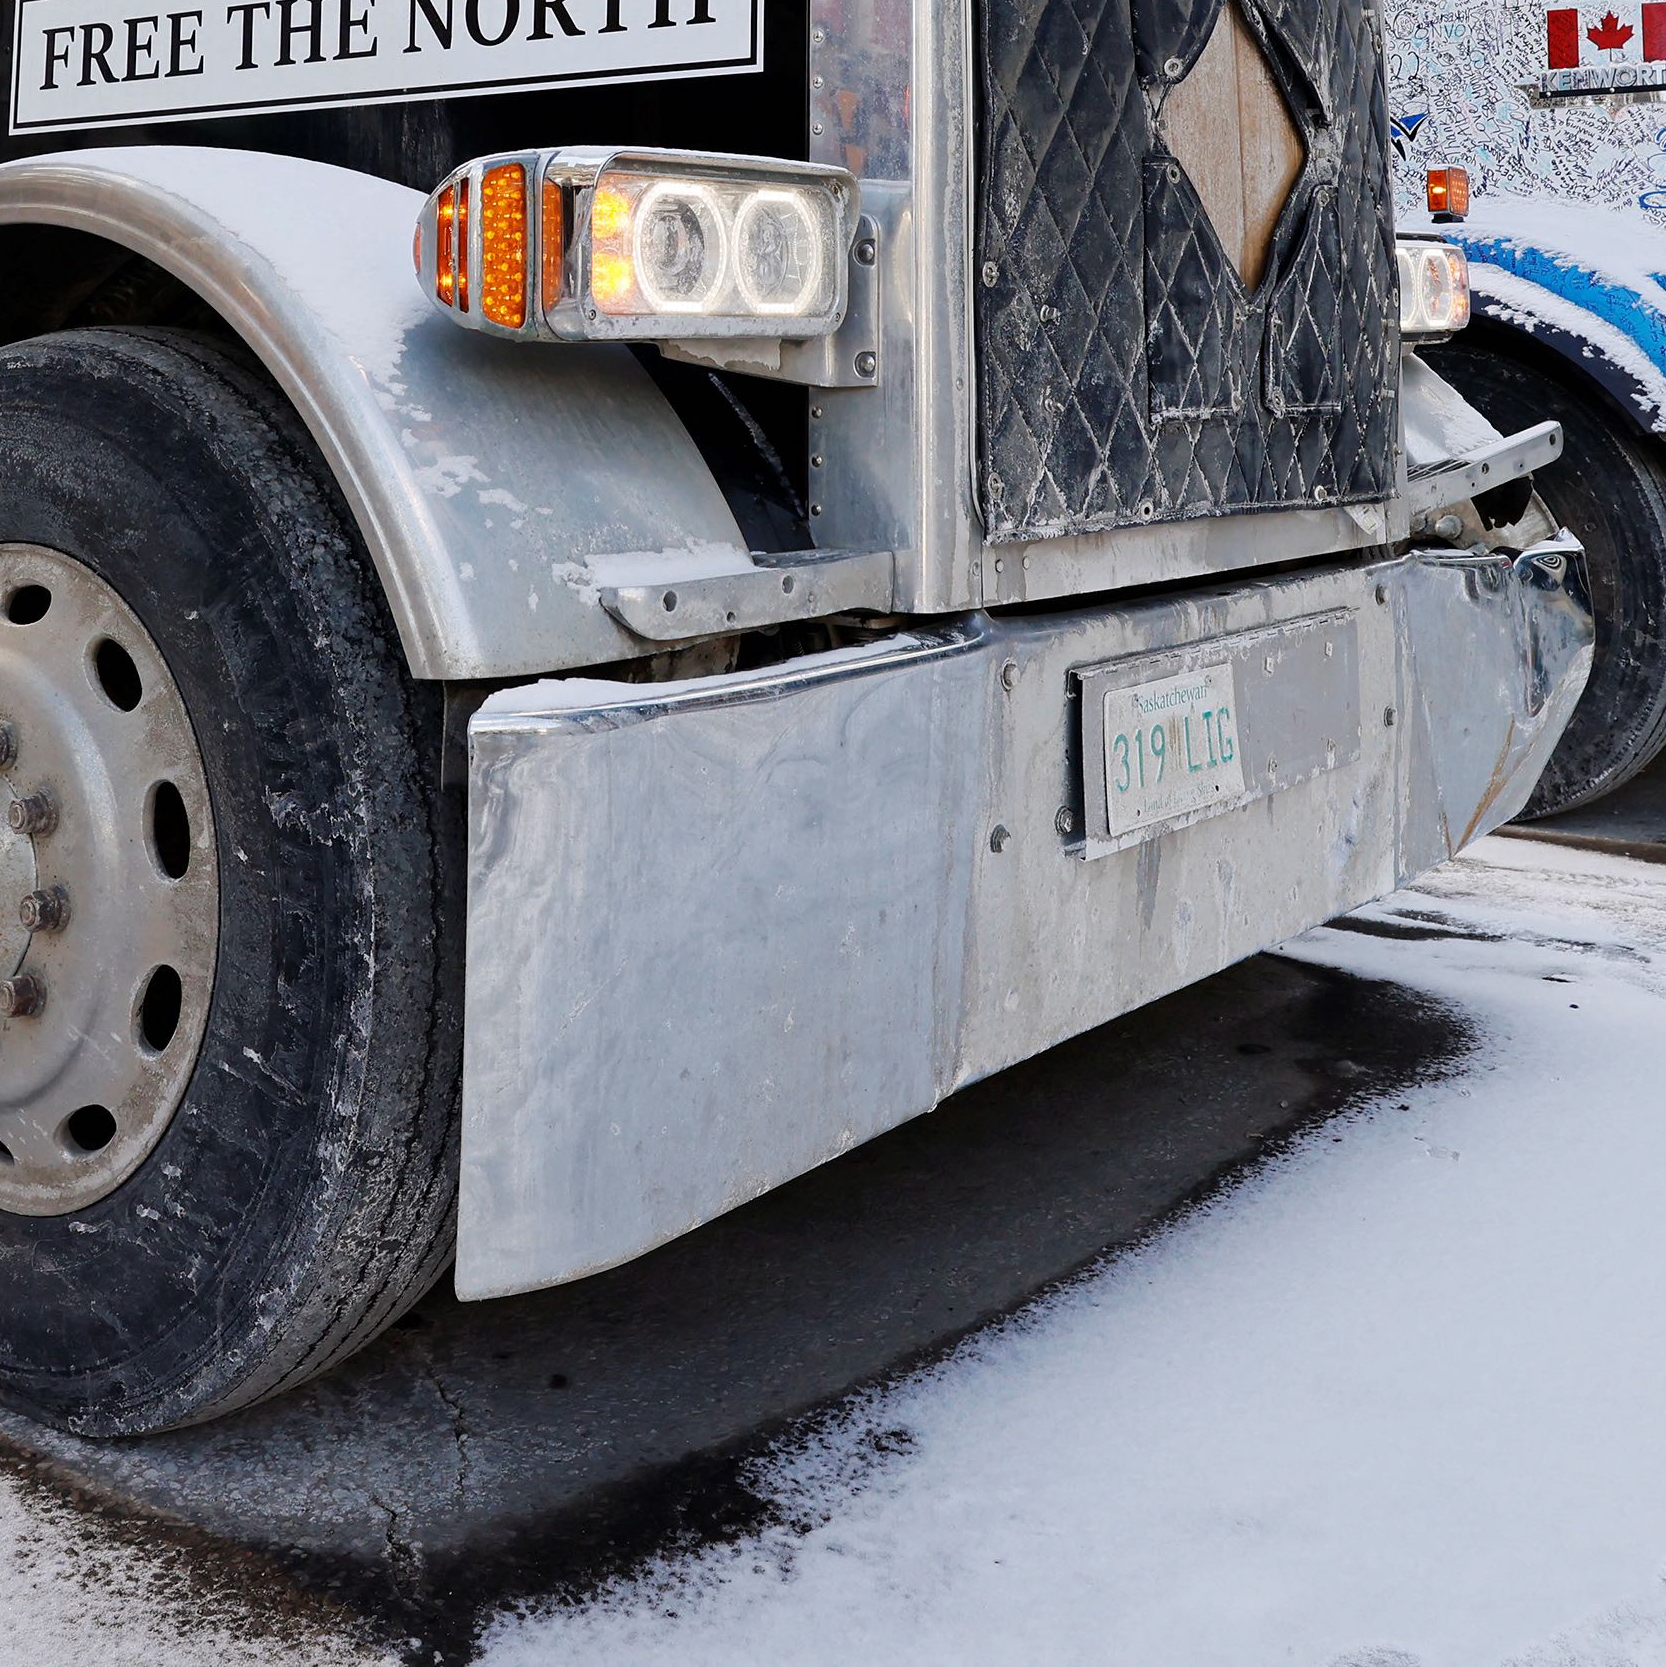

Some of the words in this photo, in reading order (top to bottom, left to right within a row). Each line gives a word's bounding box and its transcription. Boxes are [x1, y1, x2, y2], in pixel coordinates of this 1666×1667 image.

[40, 9, 206, 92] FREE
[1138, 683, 1208, 714] Saskatchewan
[1113, 723, 1166, 794] 319
[1184, 706, 1234, 773] LIG
